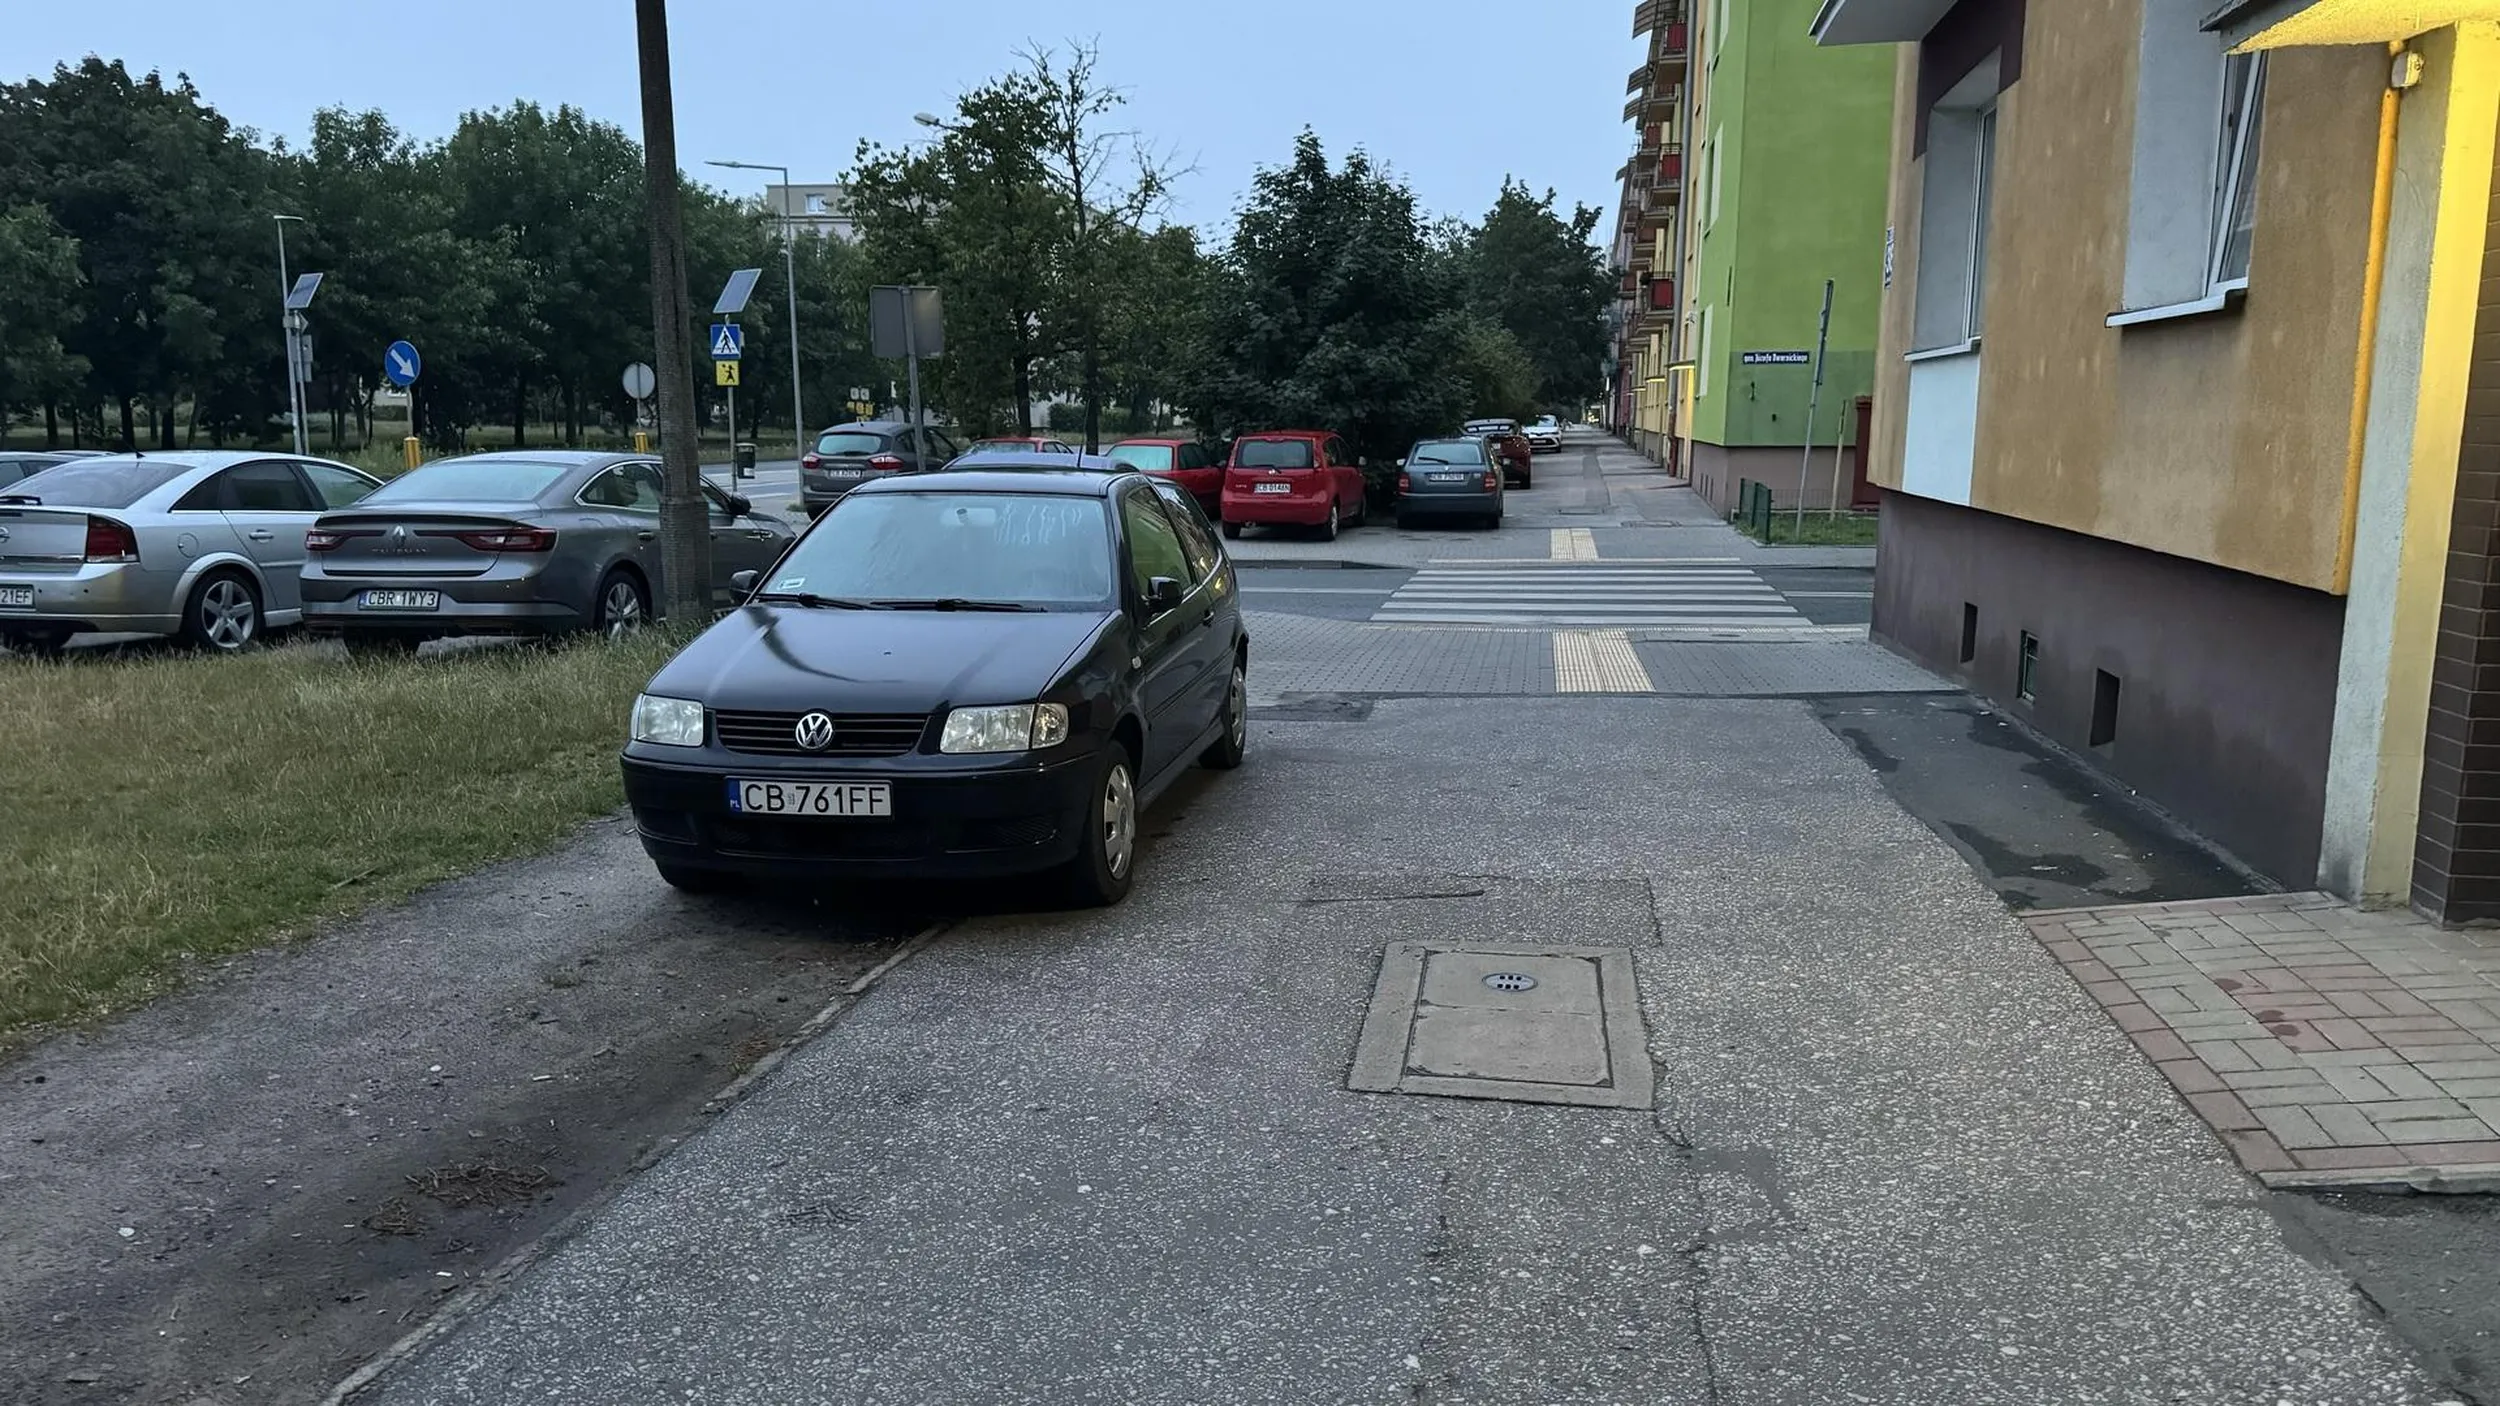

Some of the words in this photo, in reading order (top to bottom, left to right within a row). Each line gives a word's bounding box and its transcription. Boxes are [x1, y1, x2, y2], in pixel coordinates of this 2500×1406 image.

[368, 591, 396, 605] CBR
[402, 591, 436, 606] 1WY3
[729, 798, 740, 809] PL
[745, 783, 785, 812] CB
[795, 785, 885, 814] 761FF
